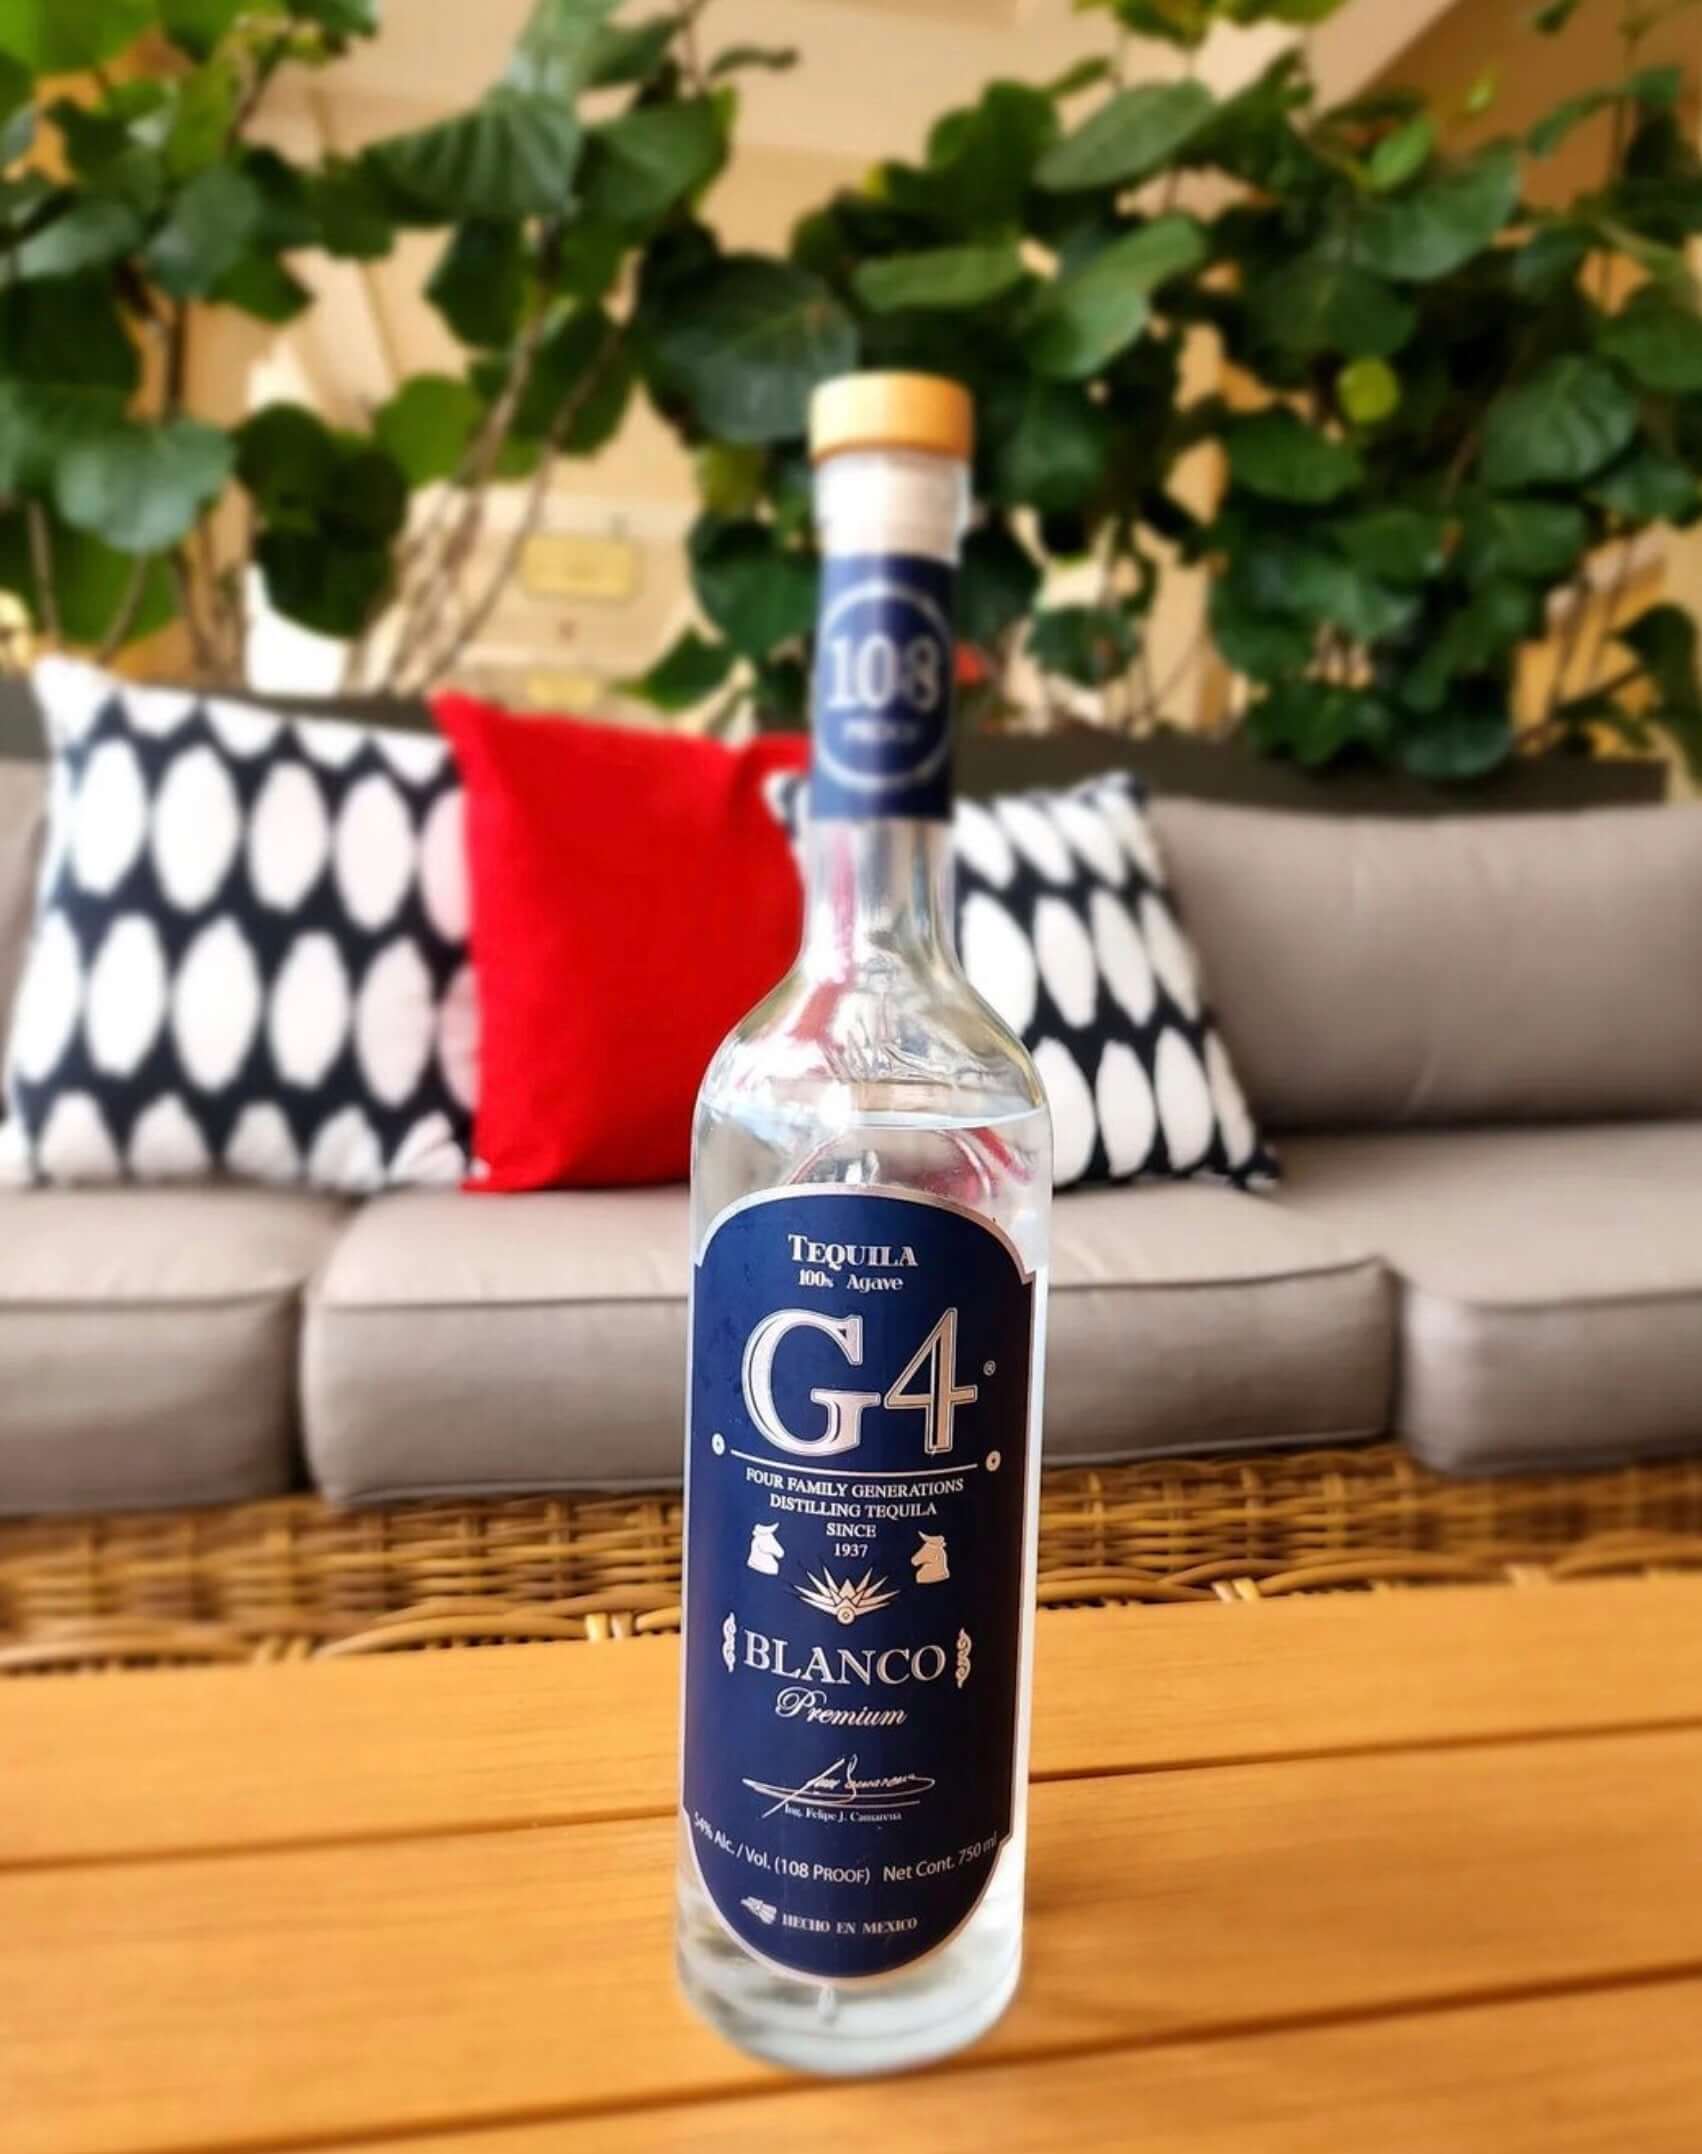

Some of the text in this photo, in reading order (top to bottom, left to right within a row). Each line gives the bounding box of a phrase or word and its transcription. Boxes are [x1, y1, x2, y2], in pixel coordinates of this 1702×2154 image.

[827, 633, 941, 713] 108
[788, 1233, 919, 1271] TEQUILA
[846, 1274, 904, 1293] Agave
[741, 1307, 978, 1457] G4
[746, 1467, 965, 1498] FOUR FAMILY GENERATIONS
[770, 1494, 937, 1521] DISTILLING TEQUILA
[826, 1522, 877, 1538] SINCE
[833, 1543, 869, 1557] 1937
[743, 1629, 946, 1686] BLANCO
[775, 1687, 908, 1727] Premium
[806, 1807, 837, 1822] Felipe
[774, 1856, 810, 1880] (108
[813, 1864, 871, 1885] PROOF)
[883, 1866, 913, 1883] Net
[915, 1855, 956, 1878] Cont.
[958, 1842, 982, 1866] 750
[782, 1914, 918, 1935] HECHO EN MEXICO
